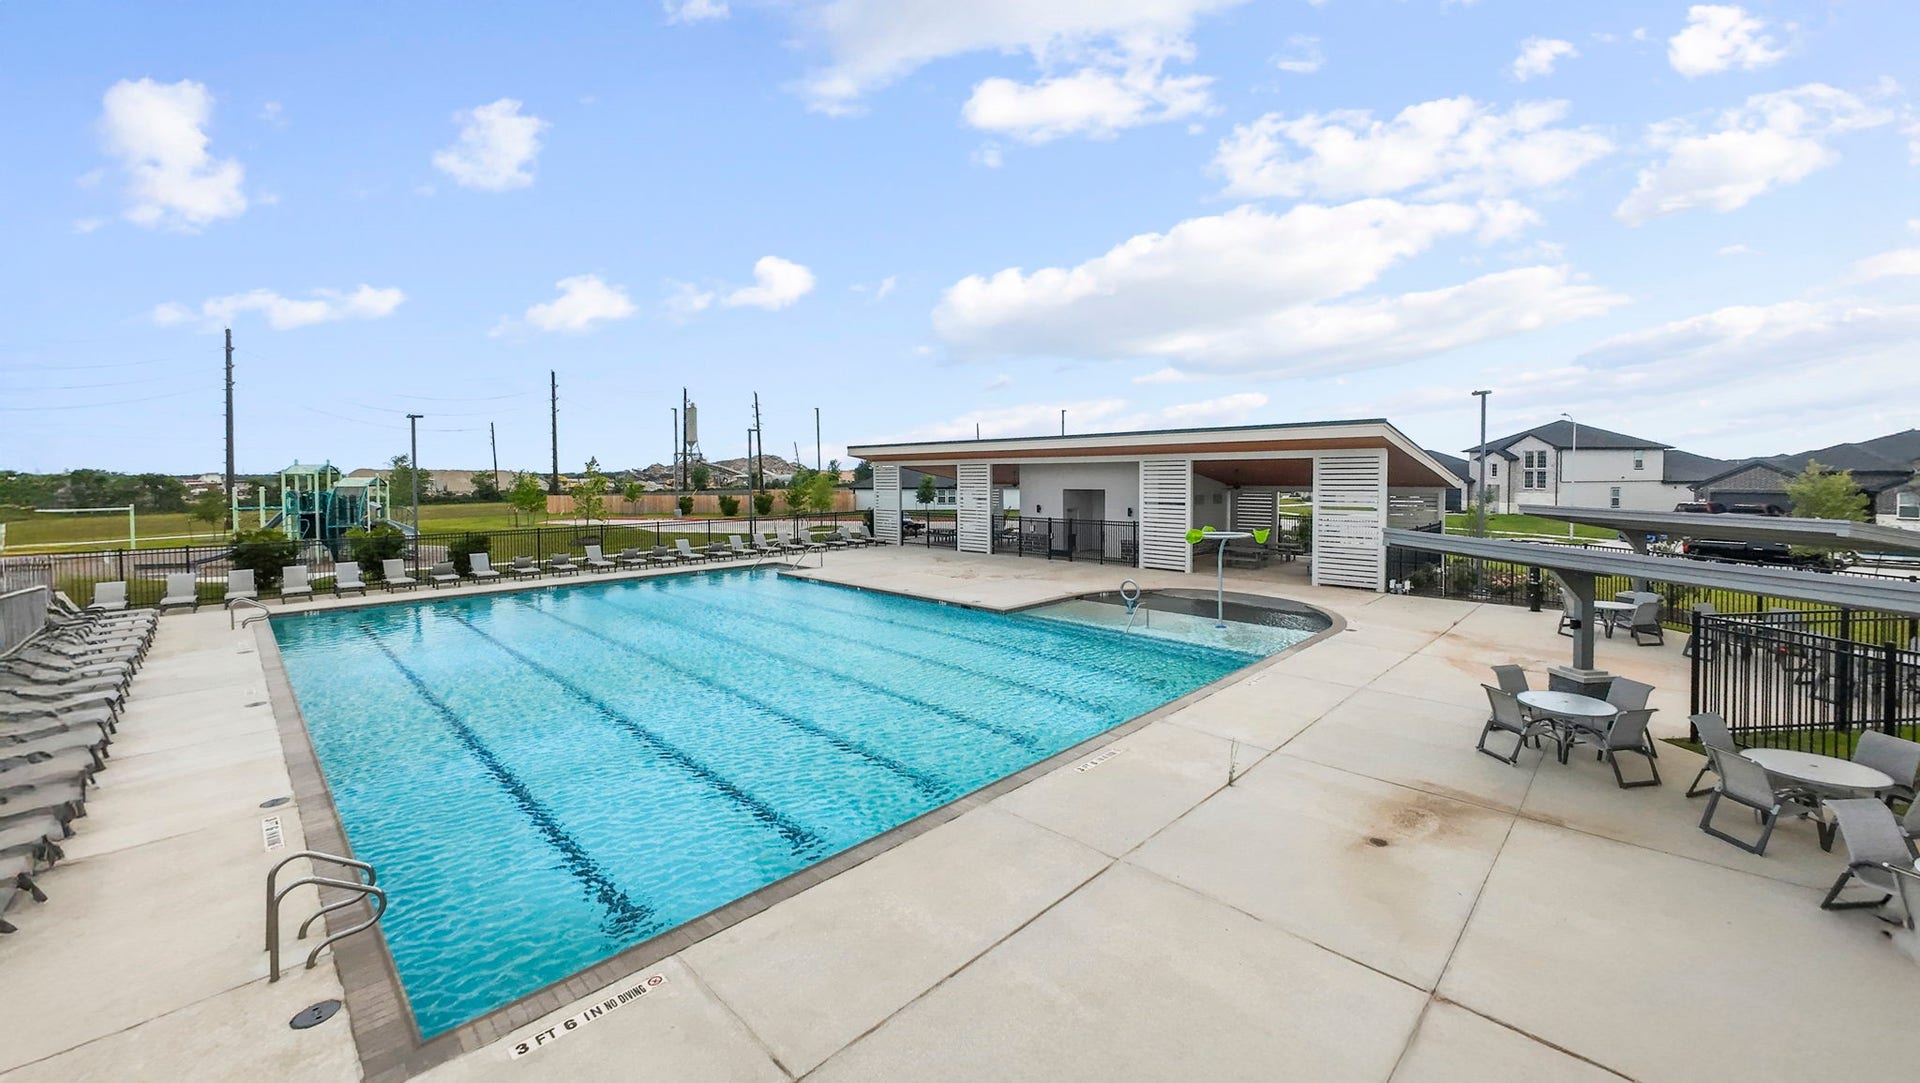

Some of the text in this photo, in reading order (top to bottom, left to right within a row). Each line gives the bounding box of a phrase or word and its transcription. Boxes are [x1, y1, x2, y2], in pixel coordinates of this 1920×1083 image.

[515, 984, 647, 1055] 3 FT 6 IN NO DIVING
